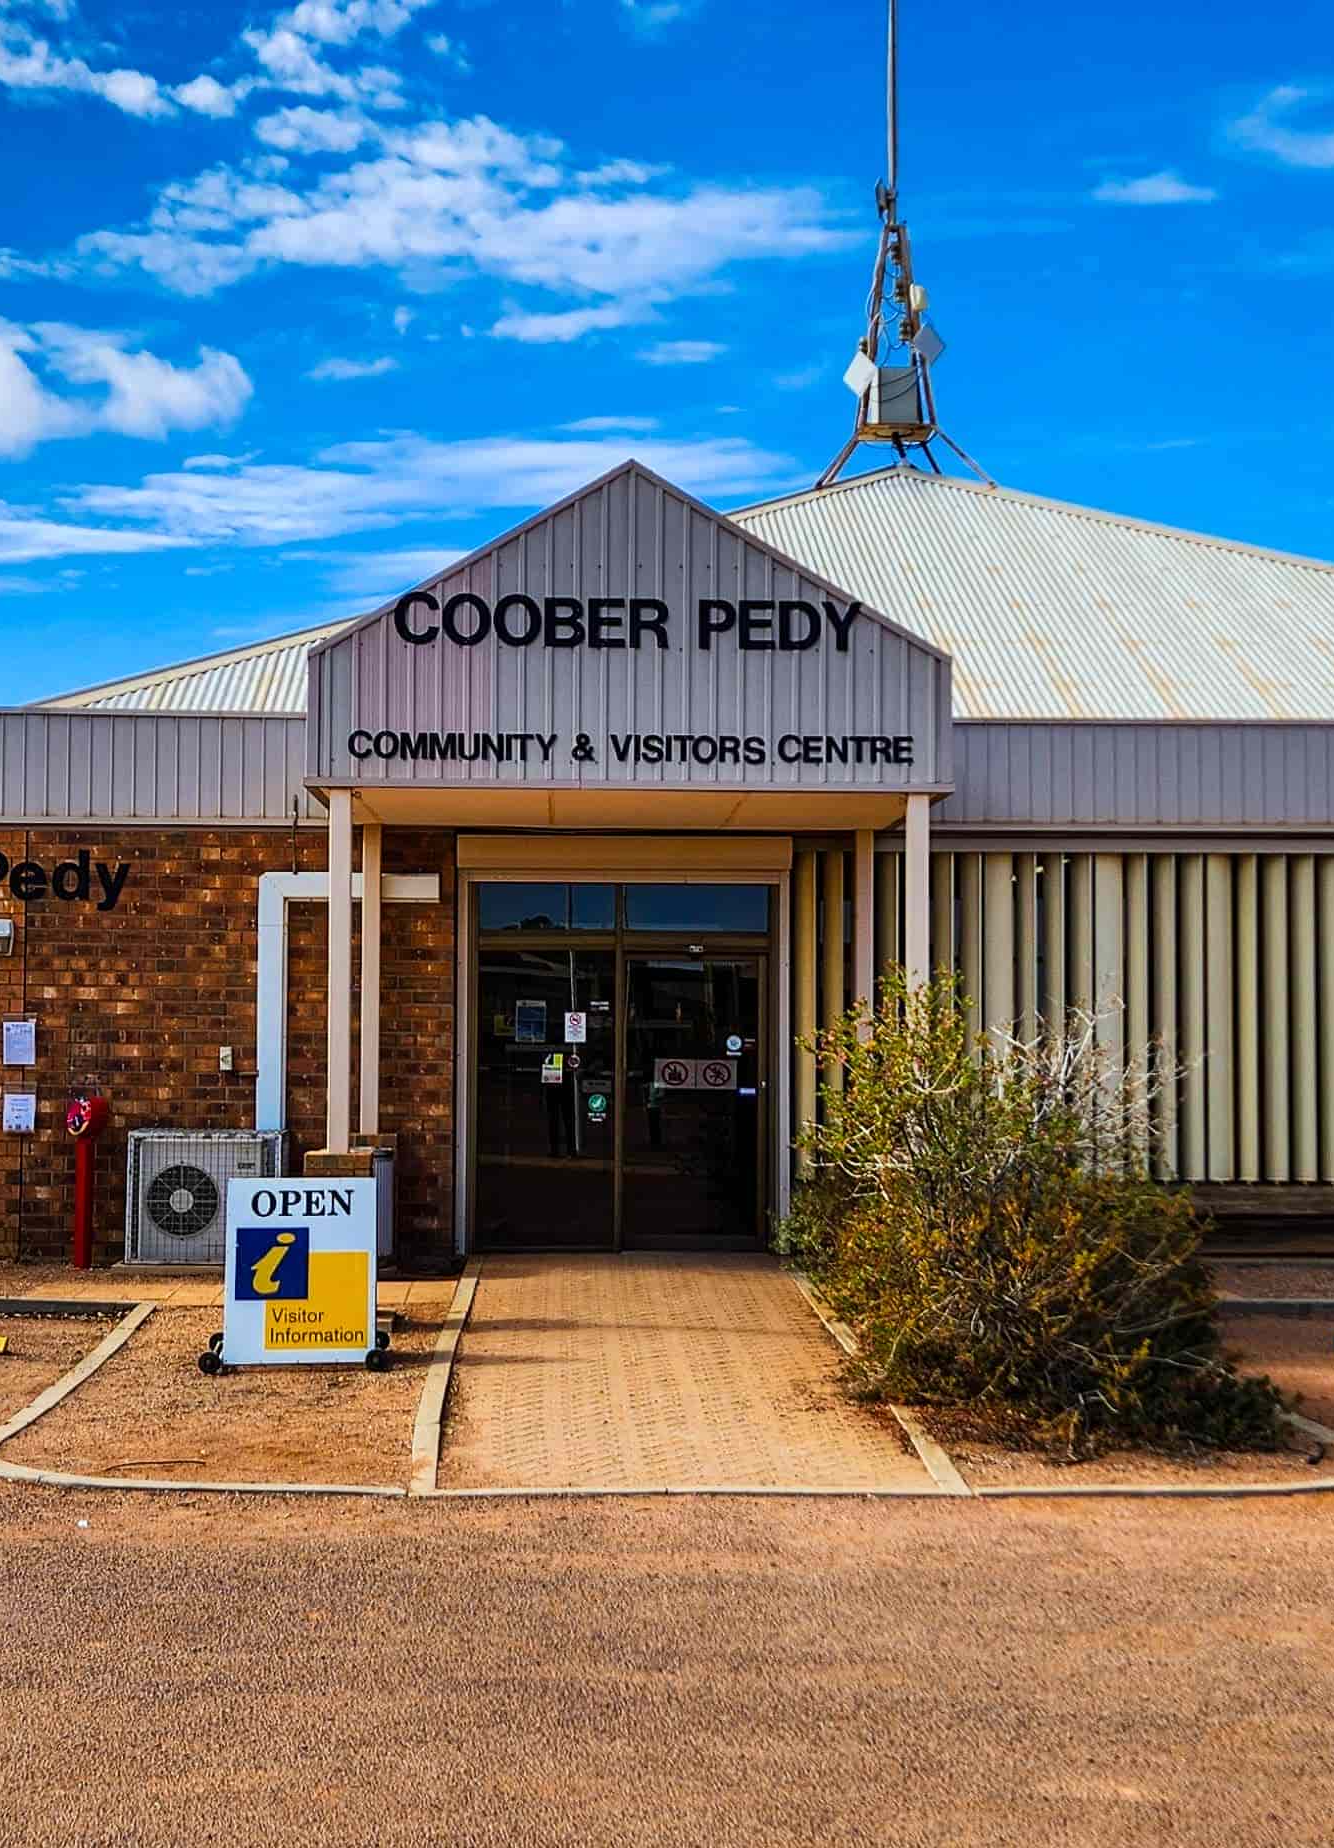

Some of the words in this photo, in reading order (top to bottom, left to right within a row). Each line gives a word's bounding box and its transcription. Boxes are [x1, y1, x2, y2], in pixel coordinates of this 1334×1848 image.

[394, 591, 668, 650] COOBER
[698, 599, 862, 652] PEDY
[347, 730, 557, 762] COMMUNITY
[571, 734, 595, 763] &
[611, 733, 766, 764] VISITORS
[777, 734, 914, 765] CENTRE
[251, 1189, 355, 1217] OPEN
[272, 1308, 325, 1324] Visitor
[269, 1326, 365, 1344] Information
